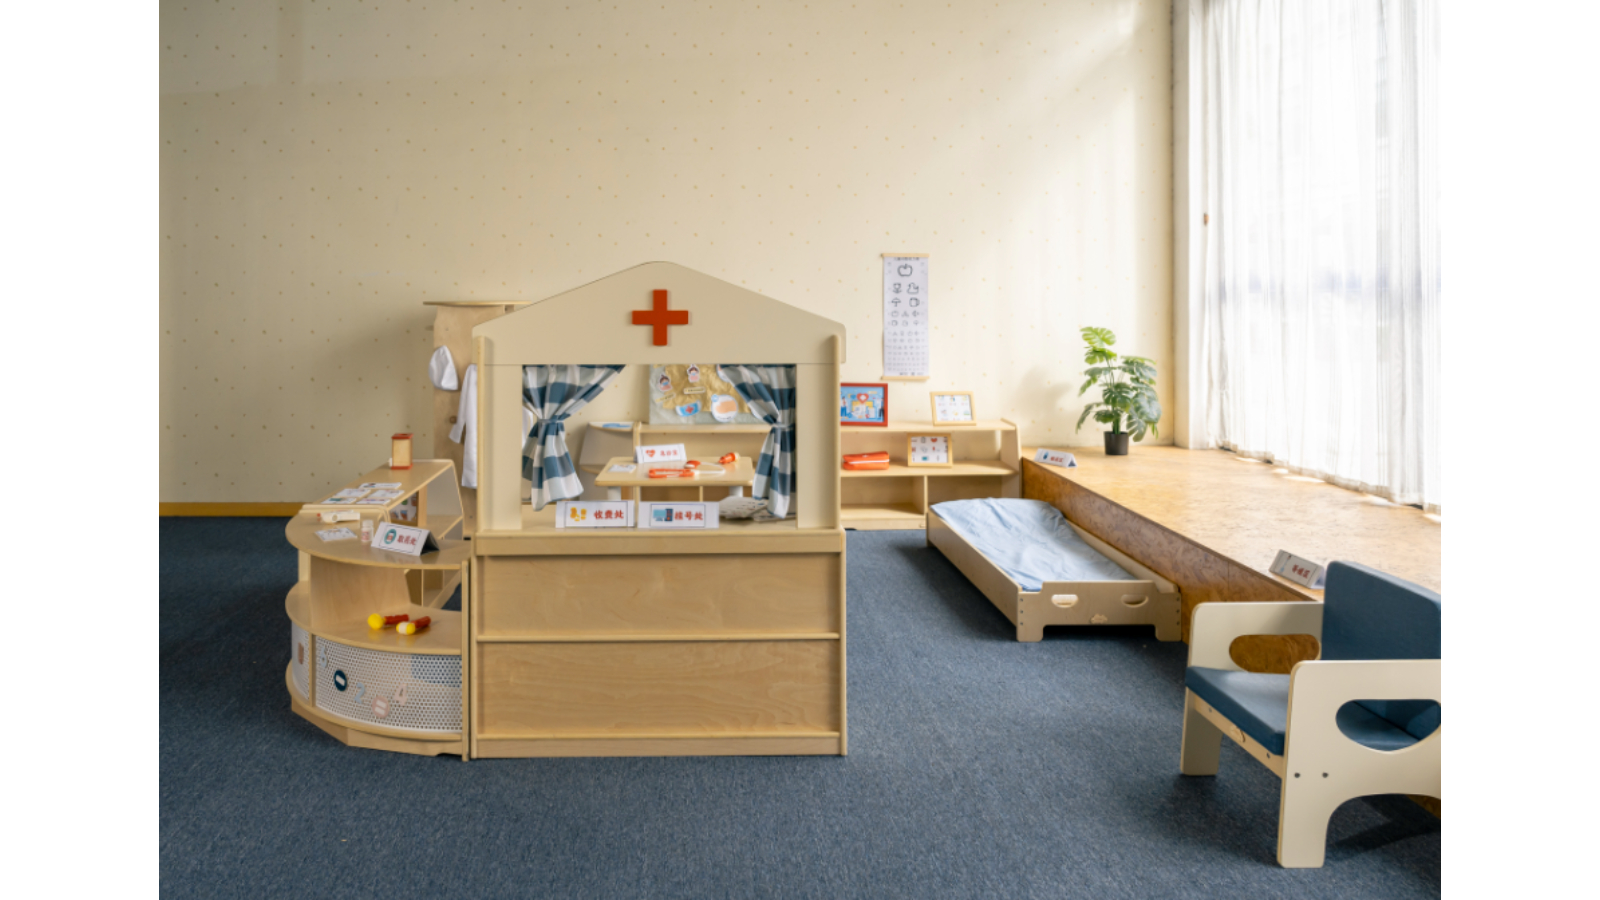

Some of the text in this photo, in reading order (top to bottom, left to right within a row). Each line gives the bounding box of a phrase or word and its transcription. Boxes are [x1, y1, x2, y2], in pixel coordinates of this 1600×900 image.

[594, 509, 624, 520] 收费处
[674, 511, 704, 521] 挂号处
